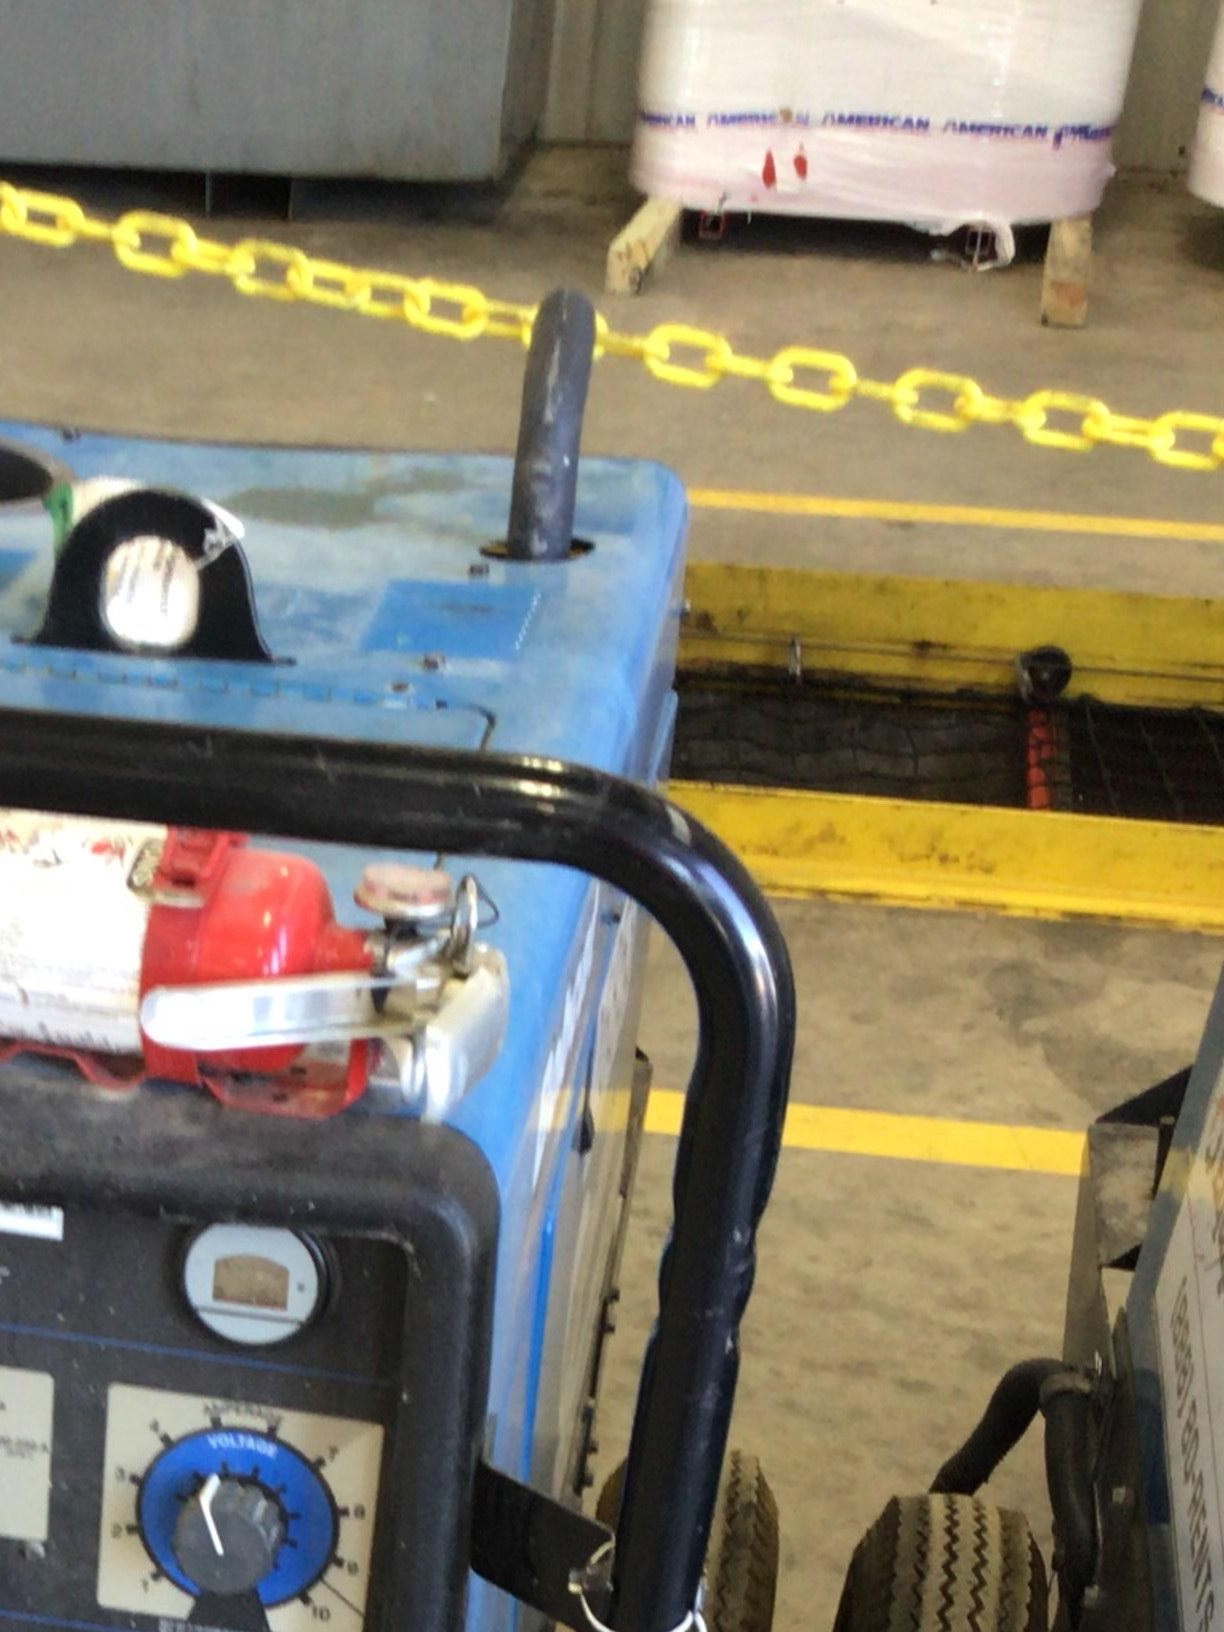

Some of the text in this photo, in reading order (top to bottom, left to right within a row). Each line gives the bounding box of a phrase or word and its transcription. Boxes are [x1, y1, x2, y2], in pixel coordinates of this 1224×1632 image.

[822, 112, 929, 130] AMERICAN
[944, 120, 1048, 138] AMERICAN
[206, 1431, 278, 1458] VOLTAGE
[311, 1605, 331, 1622] 10
